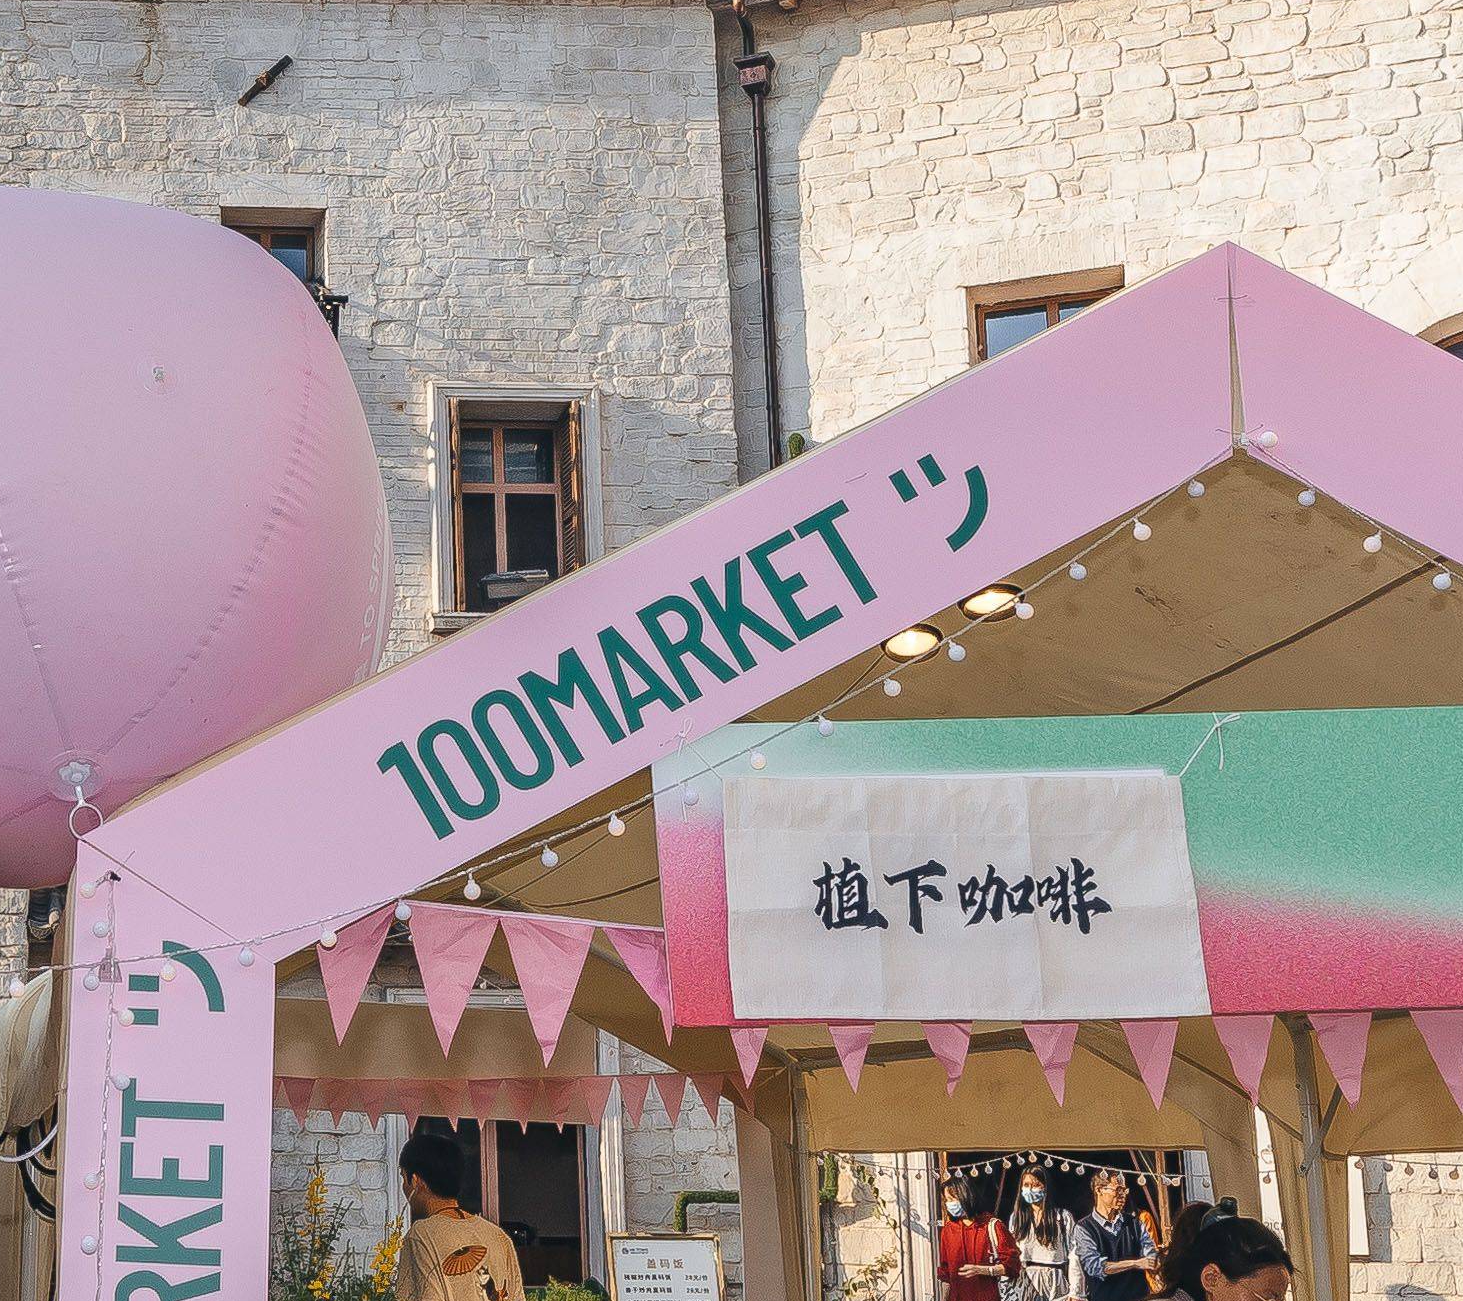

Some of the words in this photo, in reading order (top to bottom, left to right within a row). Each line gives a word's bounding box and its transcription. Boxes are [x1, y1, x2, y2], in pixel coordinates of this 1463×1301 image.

[377, 500, 878, 839] 100MARKET
[814, 857, 1113, 934] 植下咖啡
